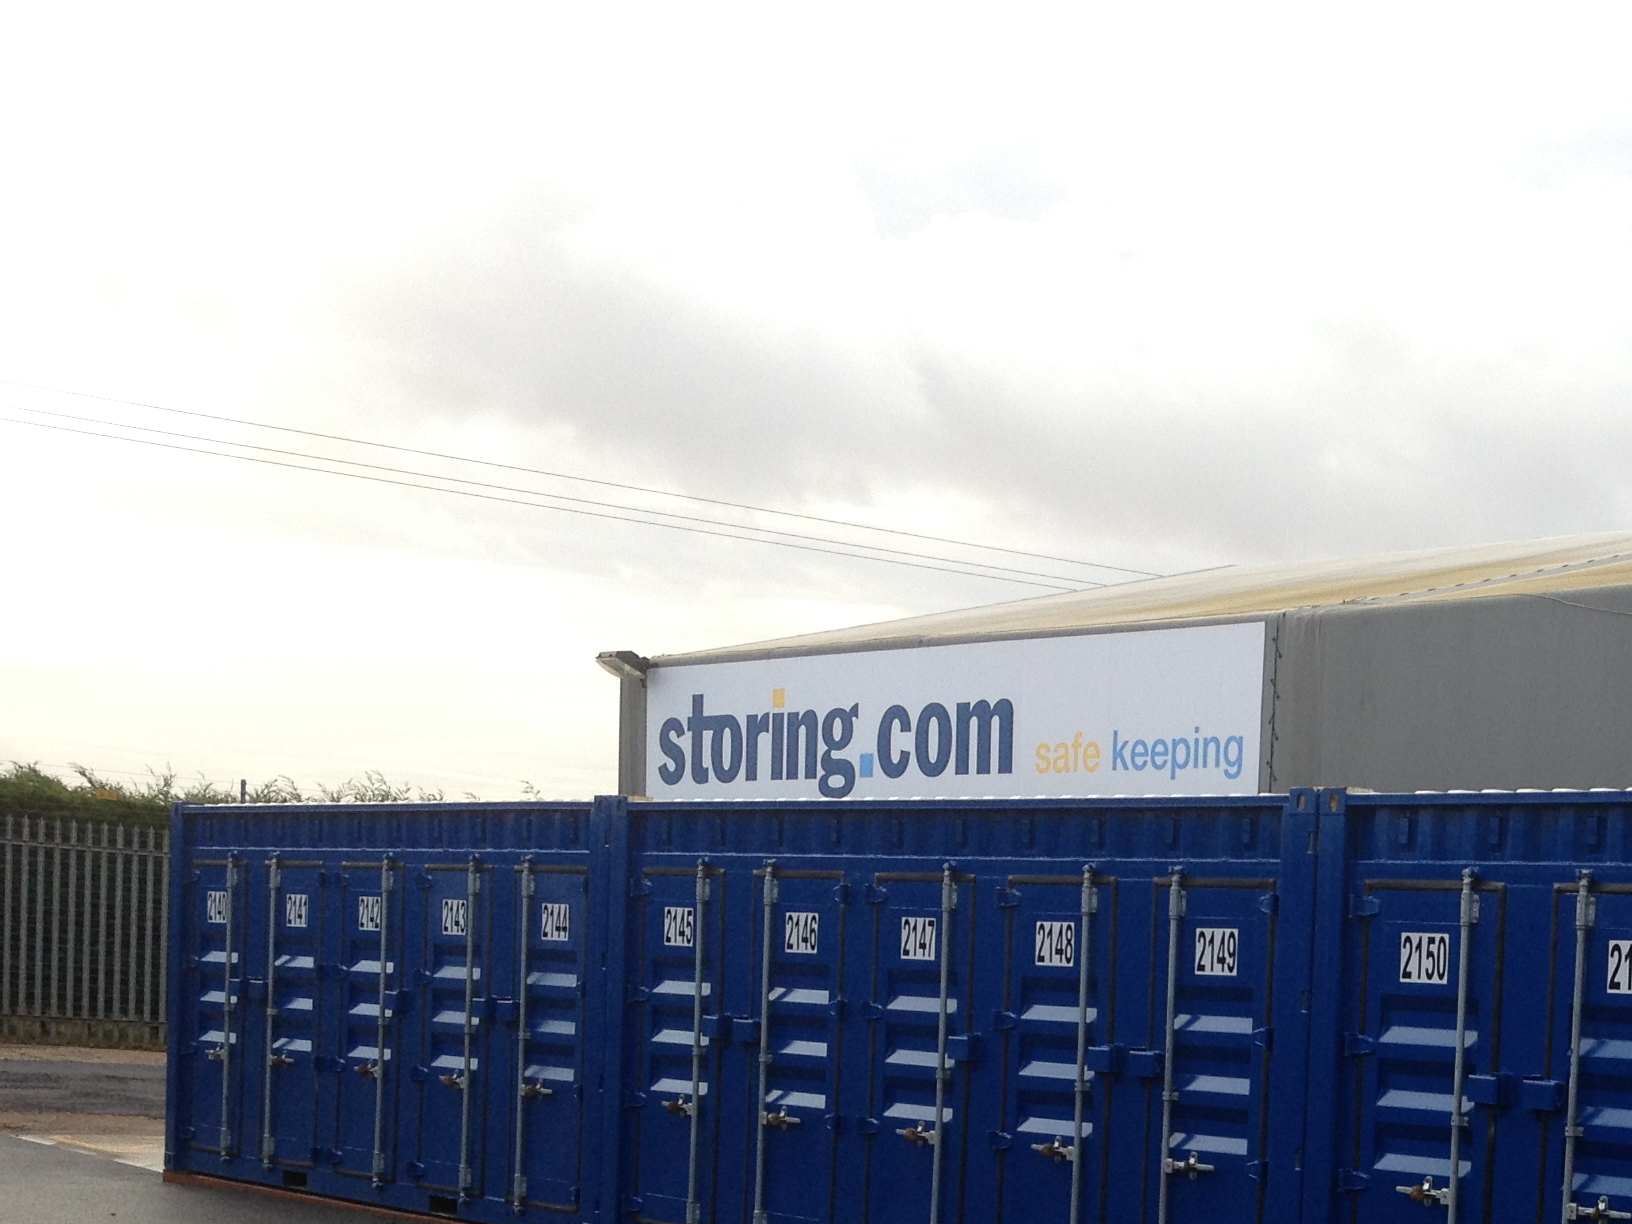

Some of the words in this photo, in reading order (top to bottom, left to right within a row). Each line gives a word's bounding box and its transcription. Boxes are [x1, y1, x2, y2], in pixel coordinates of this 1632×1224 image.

[658, 688, 1014, 798] storing.com
[1035, 732, 1100, 774] safe
[1112, 727, 1244, 780] keeping
[288, 895, 307, 925] 2141
[360, 898, 380, 928] 2142
[444, 901, 466, 933] 2143
[542, 905, 568, 939] 2144
[665, 908, 693, 943] 2145
[786, 914, 817, 950] 2146
[902, 918, 935, 957] 2147
[1037, 923, 1074, 963] 2148
[1196, 930, 1237, 973] 2149
[1401, 936, 1447, 981] 2150
